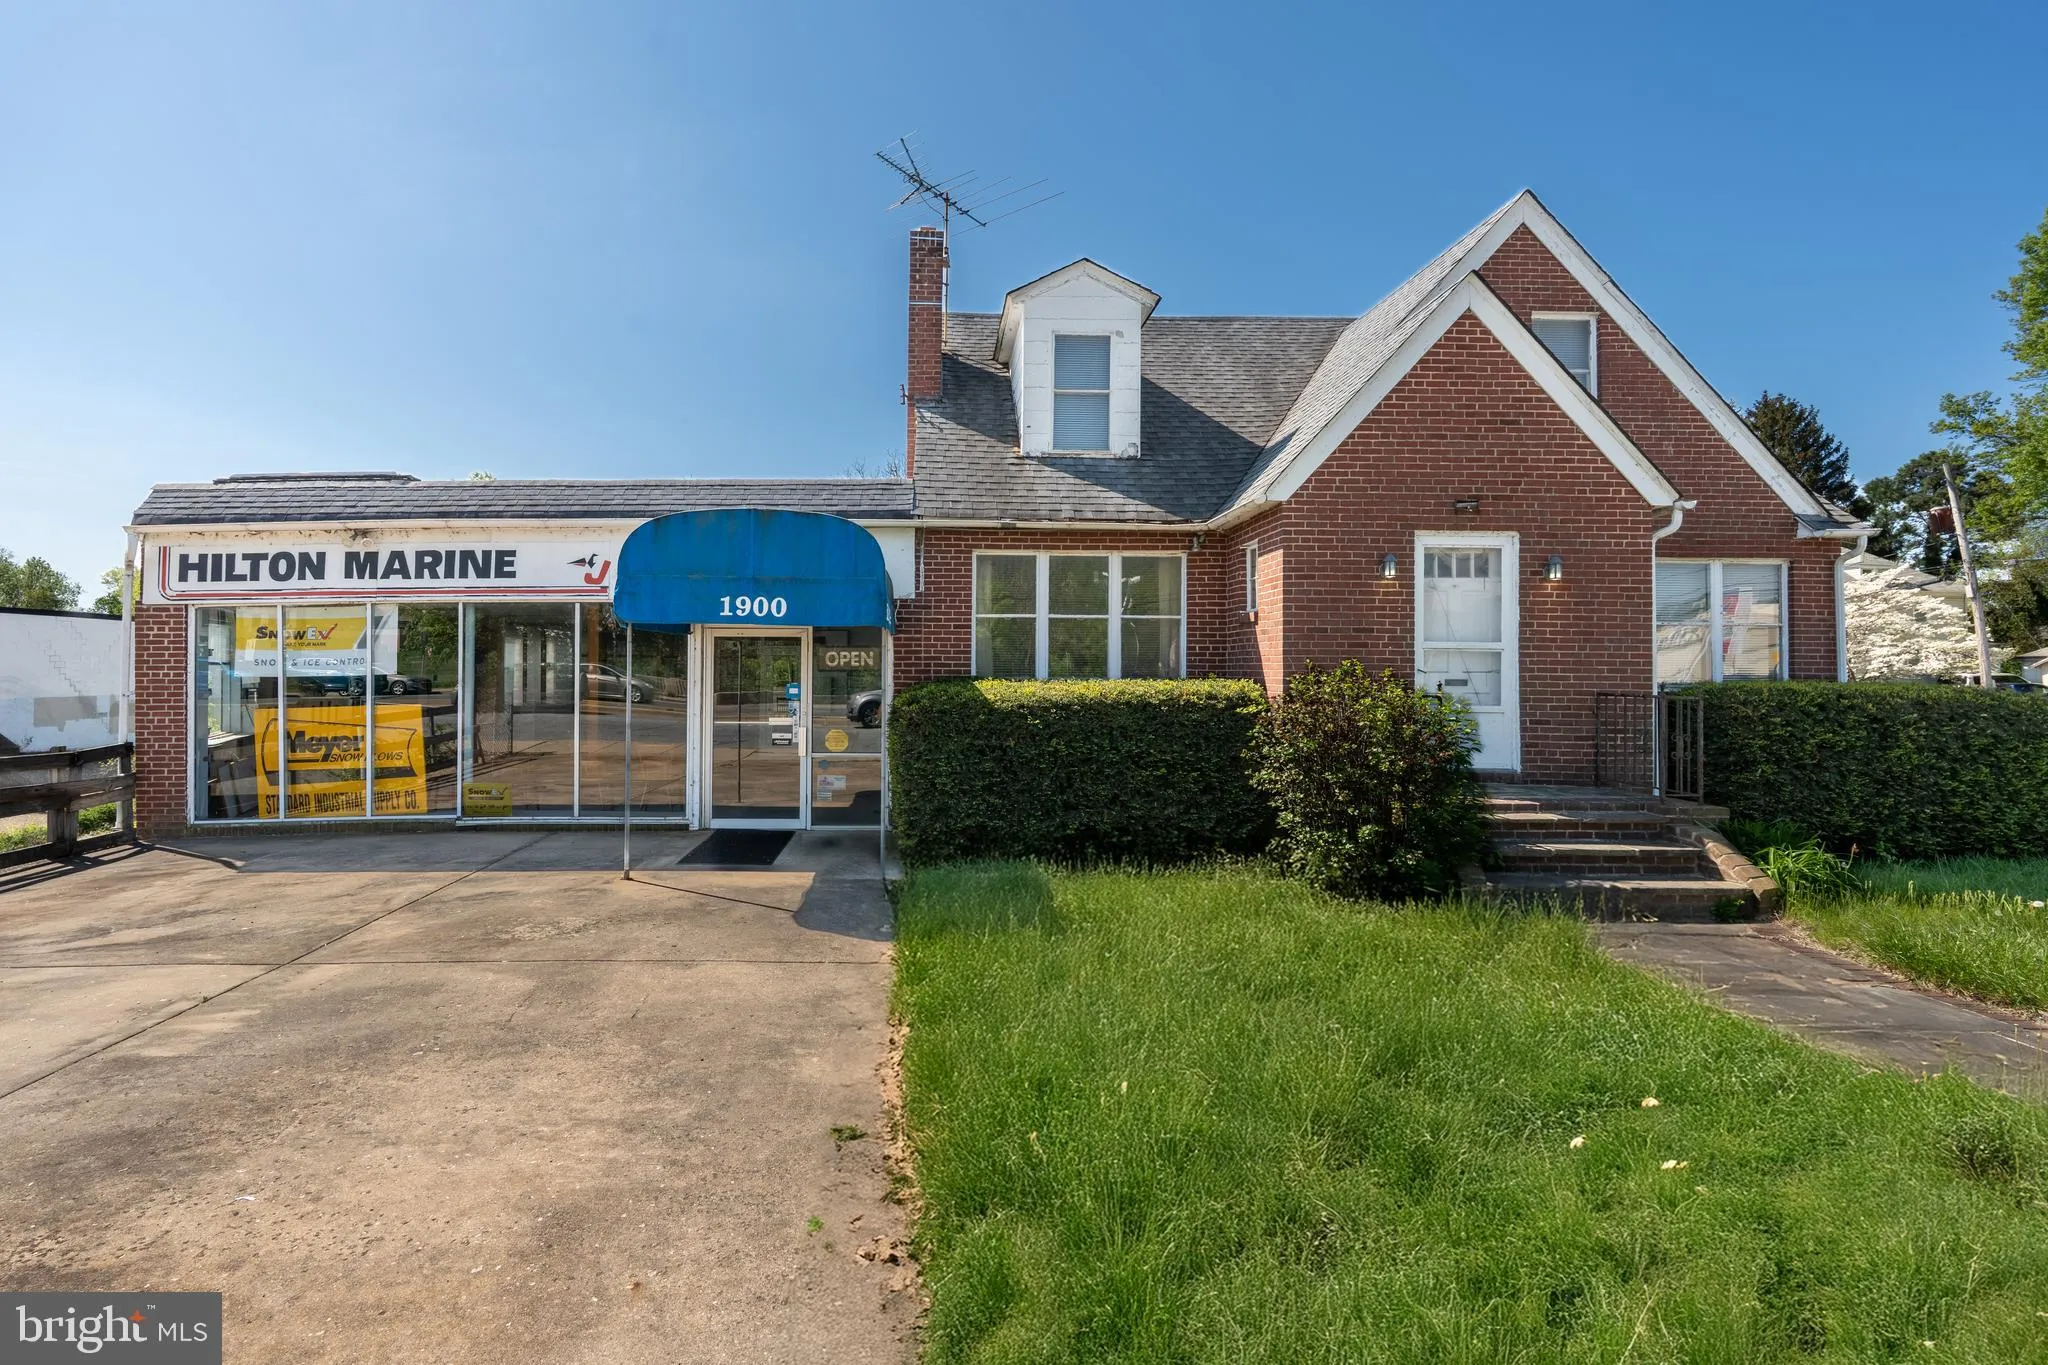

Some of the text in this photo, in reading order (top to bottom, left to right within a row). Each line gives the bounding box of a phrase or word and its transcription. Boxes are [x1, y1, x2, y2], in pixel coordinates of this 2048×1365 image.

[178, 549, 517, 583] HILTON MARINE
[719, 595, 788, 618] 1900
[254, 657, 365, 667] SNO & ICE CONTRO
[825, 651, 874, 667] OPEN
[287, 730, 364, 762] Meyer
[329, 752, 364, 763] SNOW
[313, 791, 365, 813] INDUSTRIAL
[374, 790, 400, 810] UPPLY
[404, 790, 420, 810] CO.
